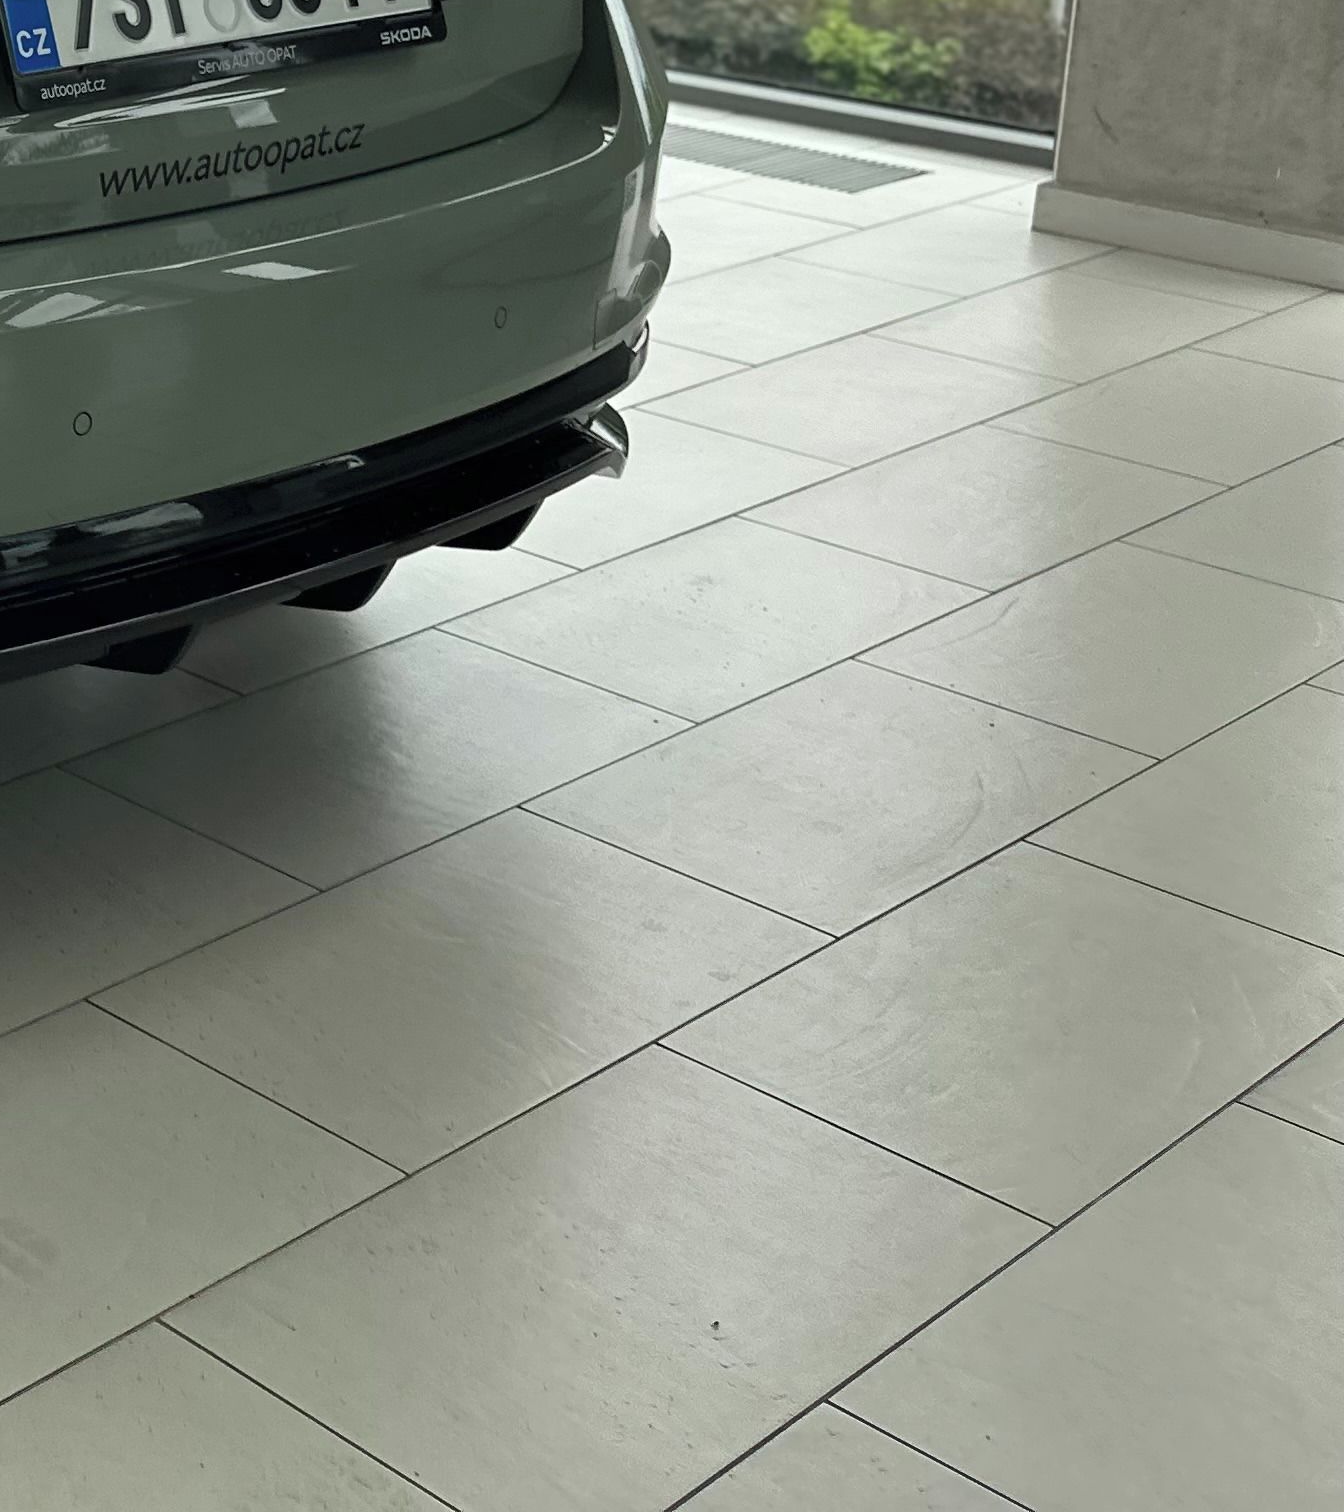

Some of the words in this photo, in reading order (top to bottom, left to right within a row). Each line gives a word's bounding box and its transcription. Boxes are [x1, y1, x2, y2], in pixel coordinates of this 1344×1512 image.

[16, 27, 52, 60] CZ
[198, 59, 231, 75] Servis
[232, 50, 265, 69] AUTO
[267, 44, 297, 64] OPAT
[40, 77, 107, 101] autoopat.cz
[100, 123, 367, 198] www.autoopat.cz
